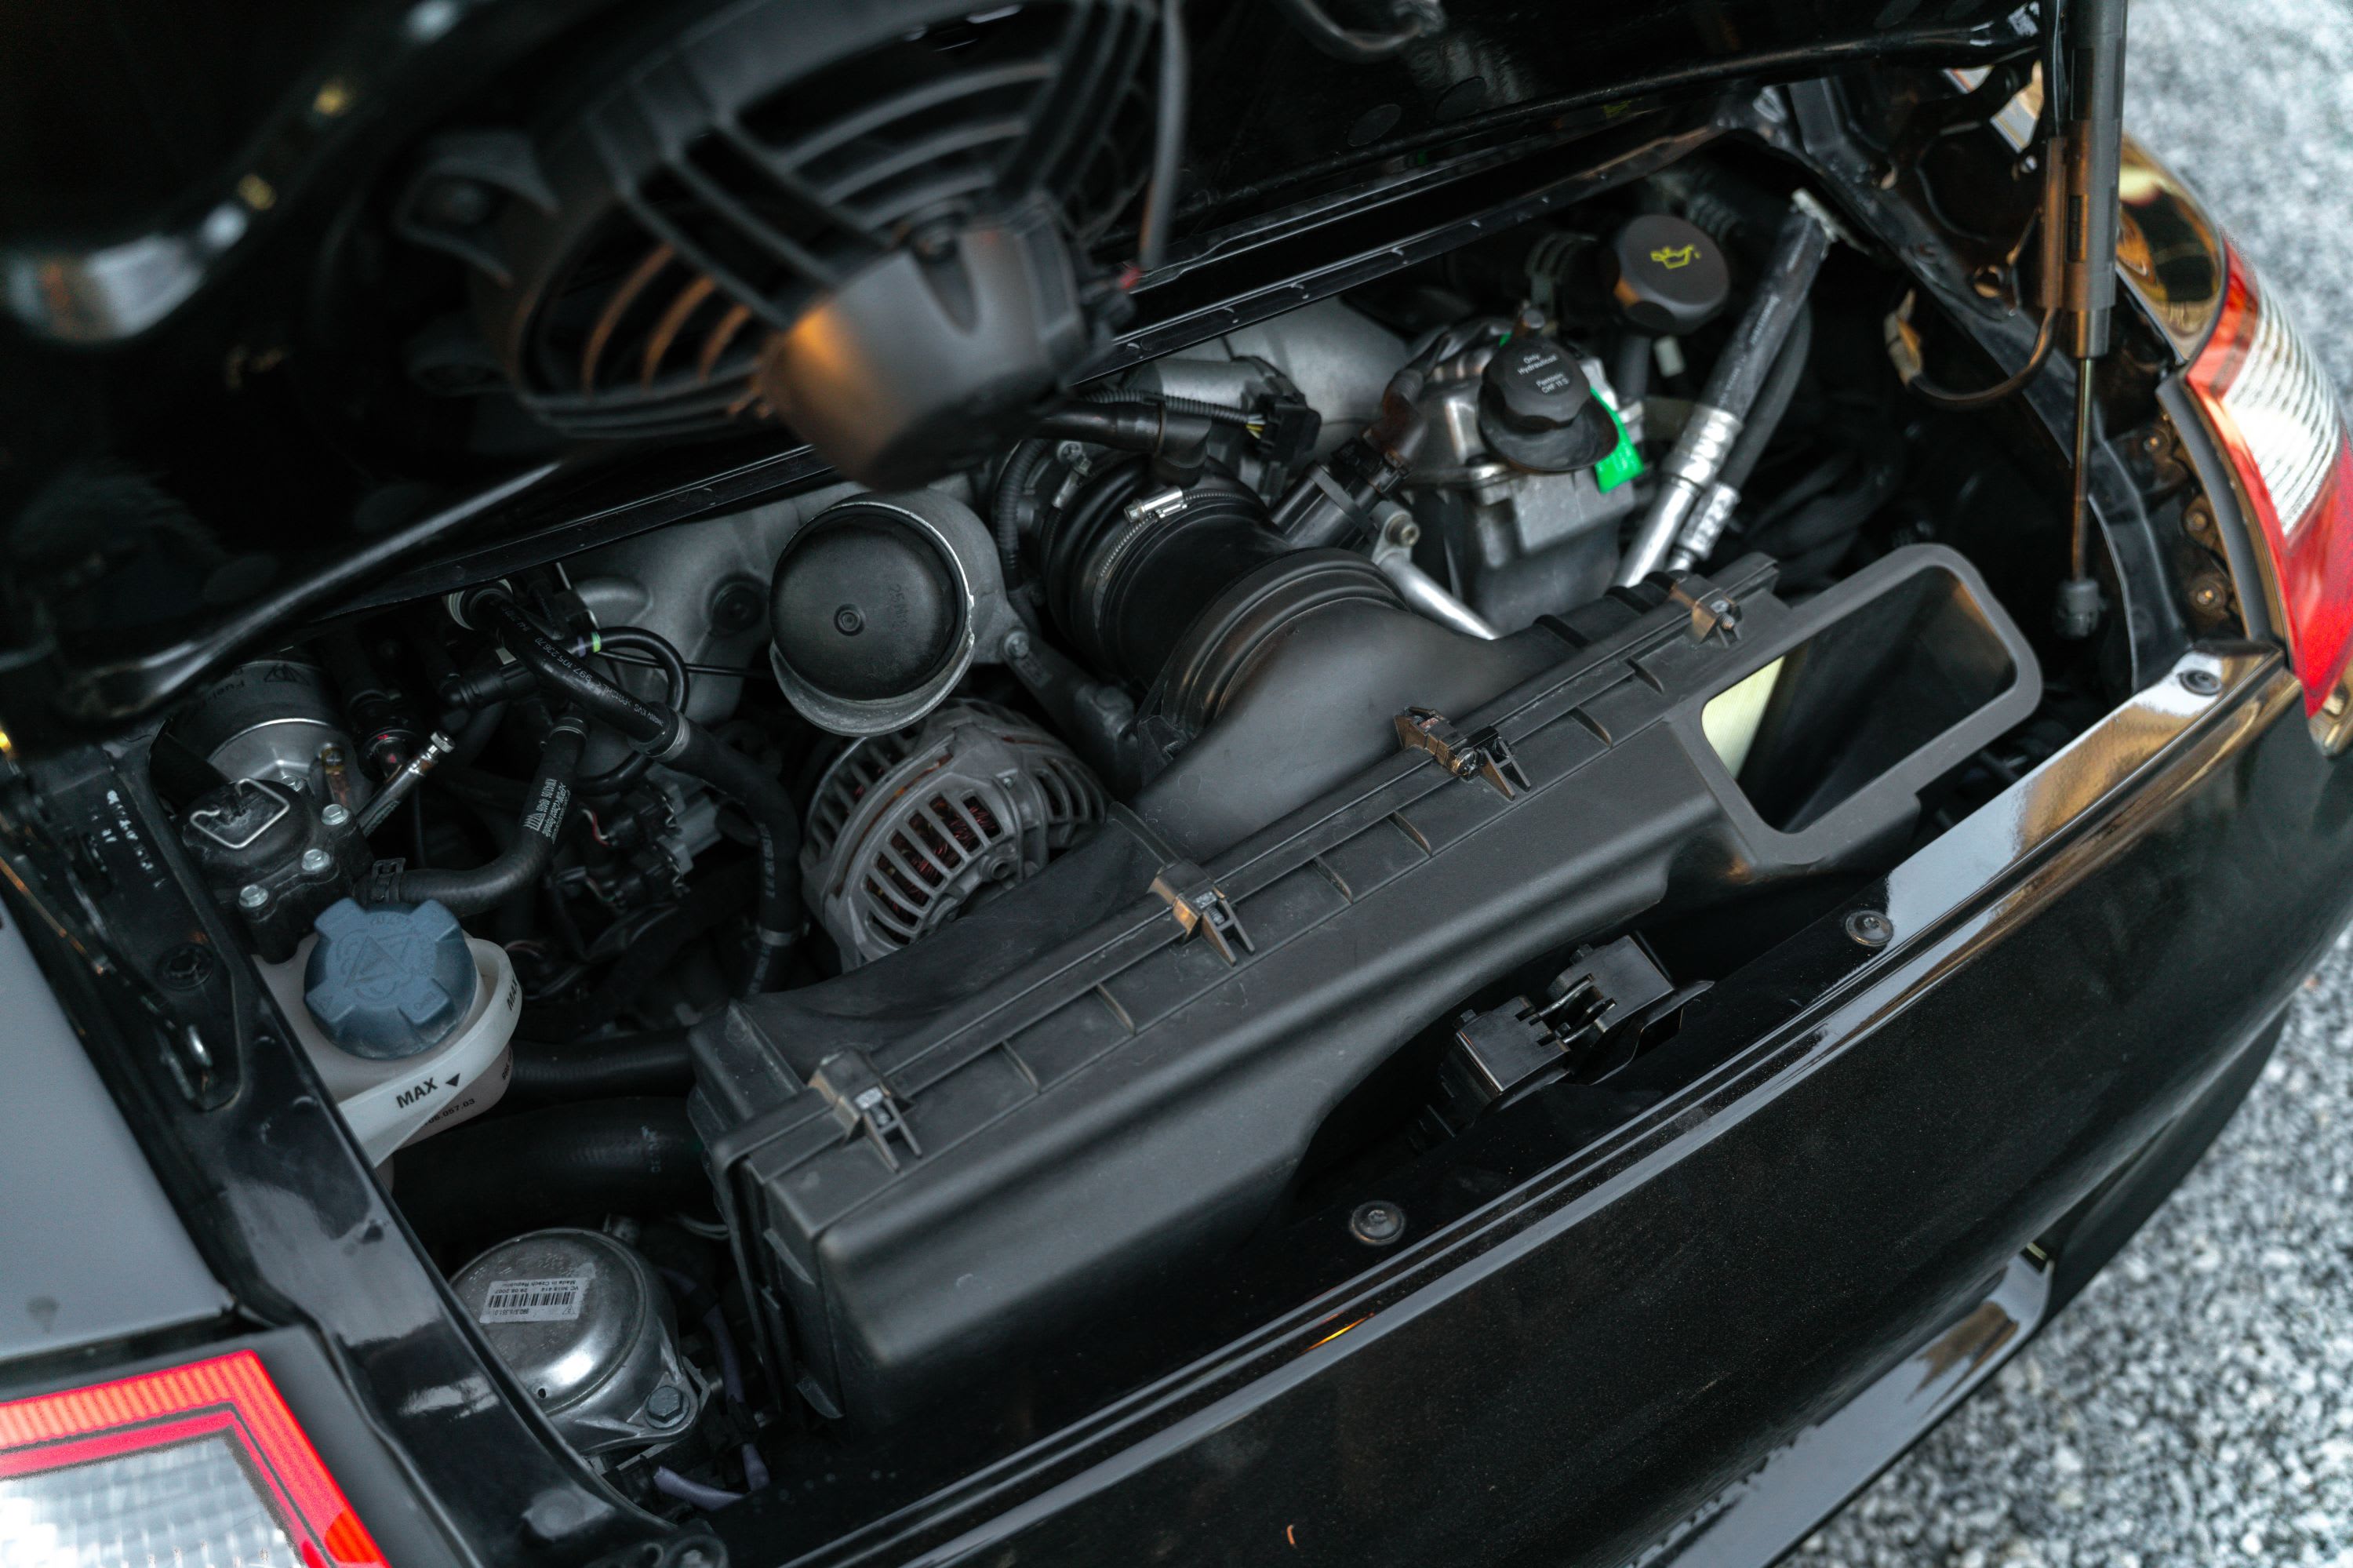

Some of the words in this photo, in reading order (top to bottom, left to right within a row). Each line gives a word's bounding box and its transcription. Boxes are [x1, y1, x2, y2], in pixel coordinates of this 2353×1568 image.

[1523, 354, 1540, 364] Only
[507, 976, 518, 1011] MAX
[395, 1077, 438, 1108] MAX
